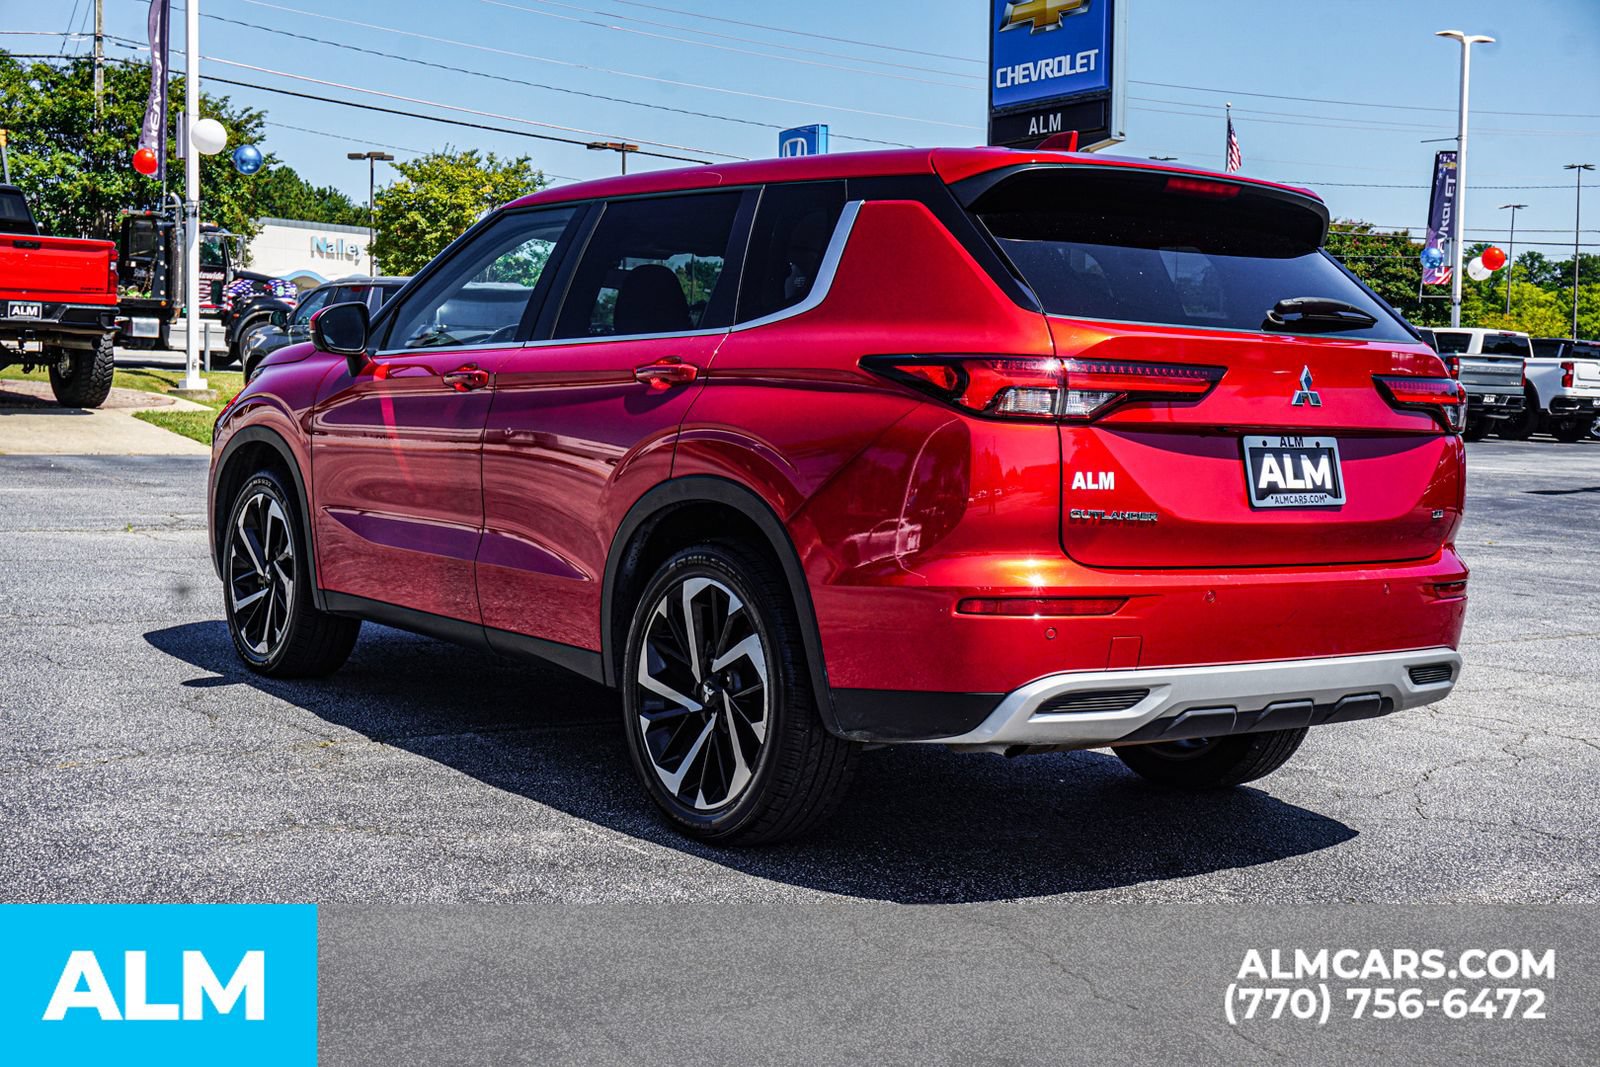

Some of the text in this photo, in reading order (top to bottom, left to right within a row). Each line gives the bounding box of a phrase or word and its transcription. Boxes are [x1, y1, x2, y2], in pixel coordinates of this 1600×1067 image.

[996, 49, 1099, 88] CHEVROLET
[1028, 113, 1062, 135] ALM
[310, 235, 361, 261] Nalley
[11, 305, 38, 316] ALM
[1280, 436, 1304, 448] ALM
[1071, 471, 1115, 490] ALM
[1258, 453, 1333, 489] ALM
[1274, 494, 1326, 505] ALMCARS.COM
[1070, 508, 1158, 522] OUTLANDER
